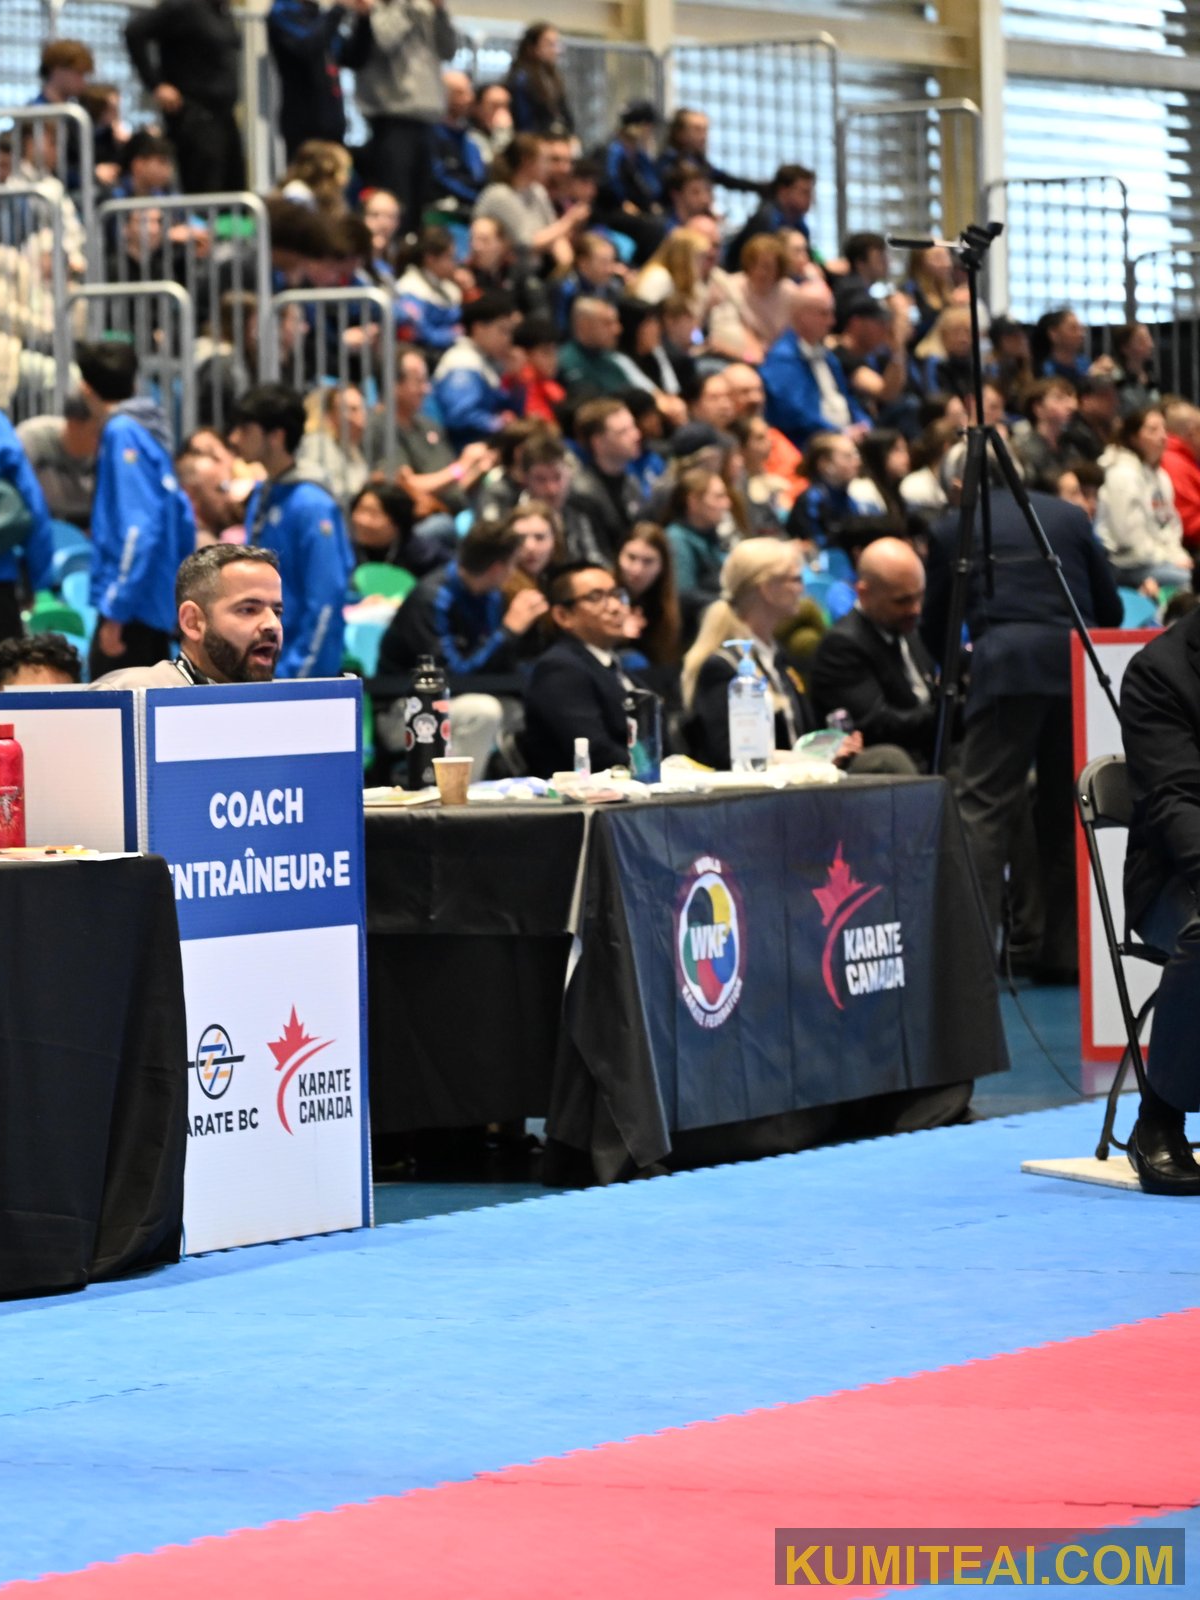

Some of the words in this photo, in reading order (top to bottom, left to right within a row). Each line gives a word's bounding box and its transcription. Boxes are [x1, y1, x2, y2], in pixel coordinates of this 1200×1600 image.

[209, 787, 304, 829] COACH
[168, 847, 350, 900] NTRAÎNEUR·E
[690, 923, 728, 962] WKF
[843, 921, 903, 962] KARATE
[845, 956, 905, 996] CANADA
[299, 1068, 351, 1097] KARATE
[187, 1111, 234, 1137] ARATE
[238, 1107, 259, 1131] BC
[299, 1096, 353, 1124] CANADA
